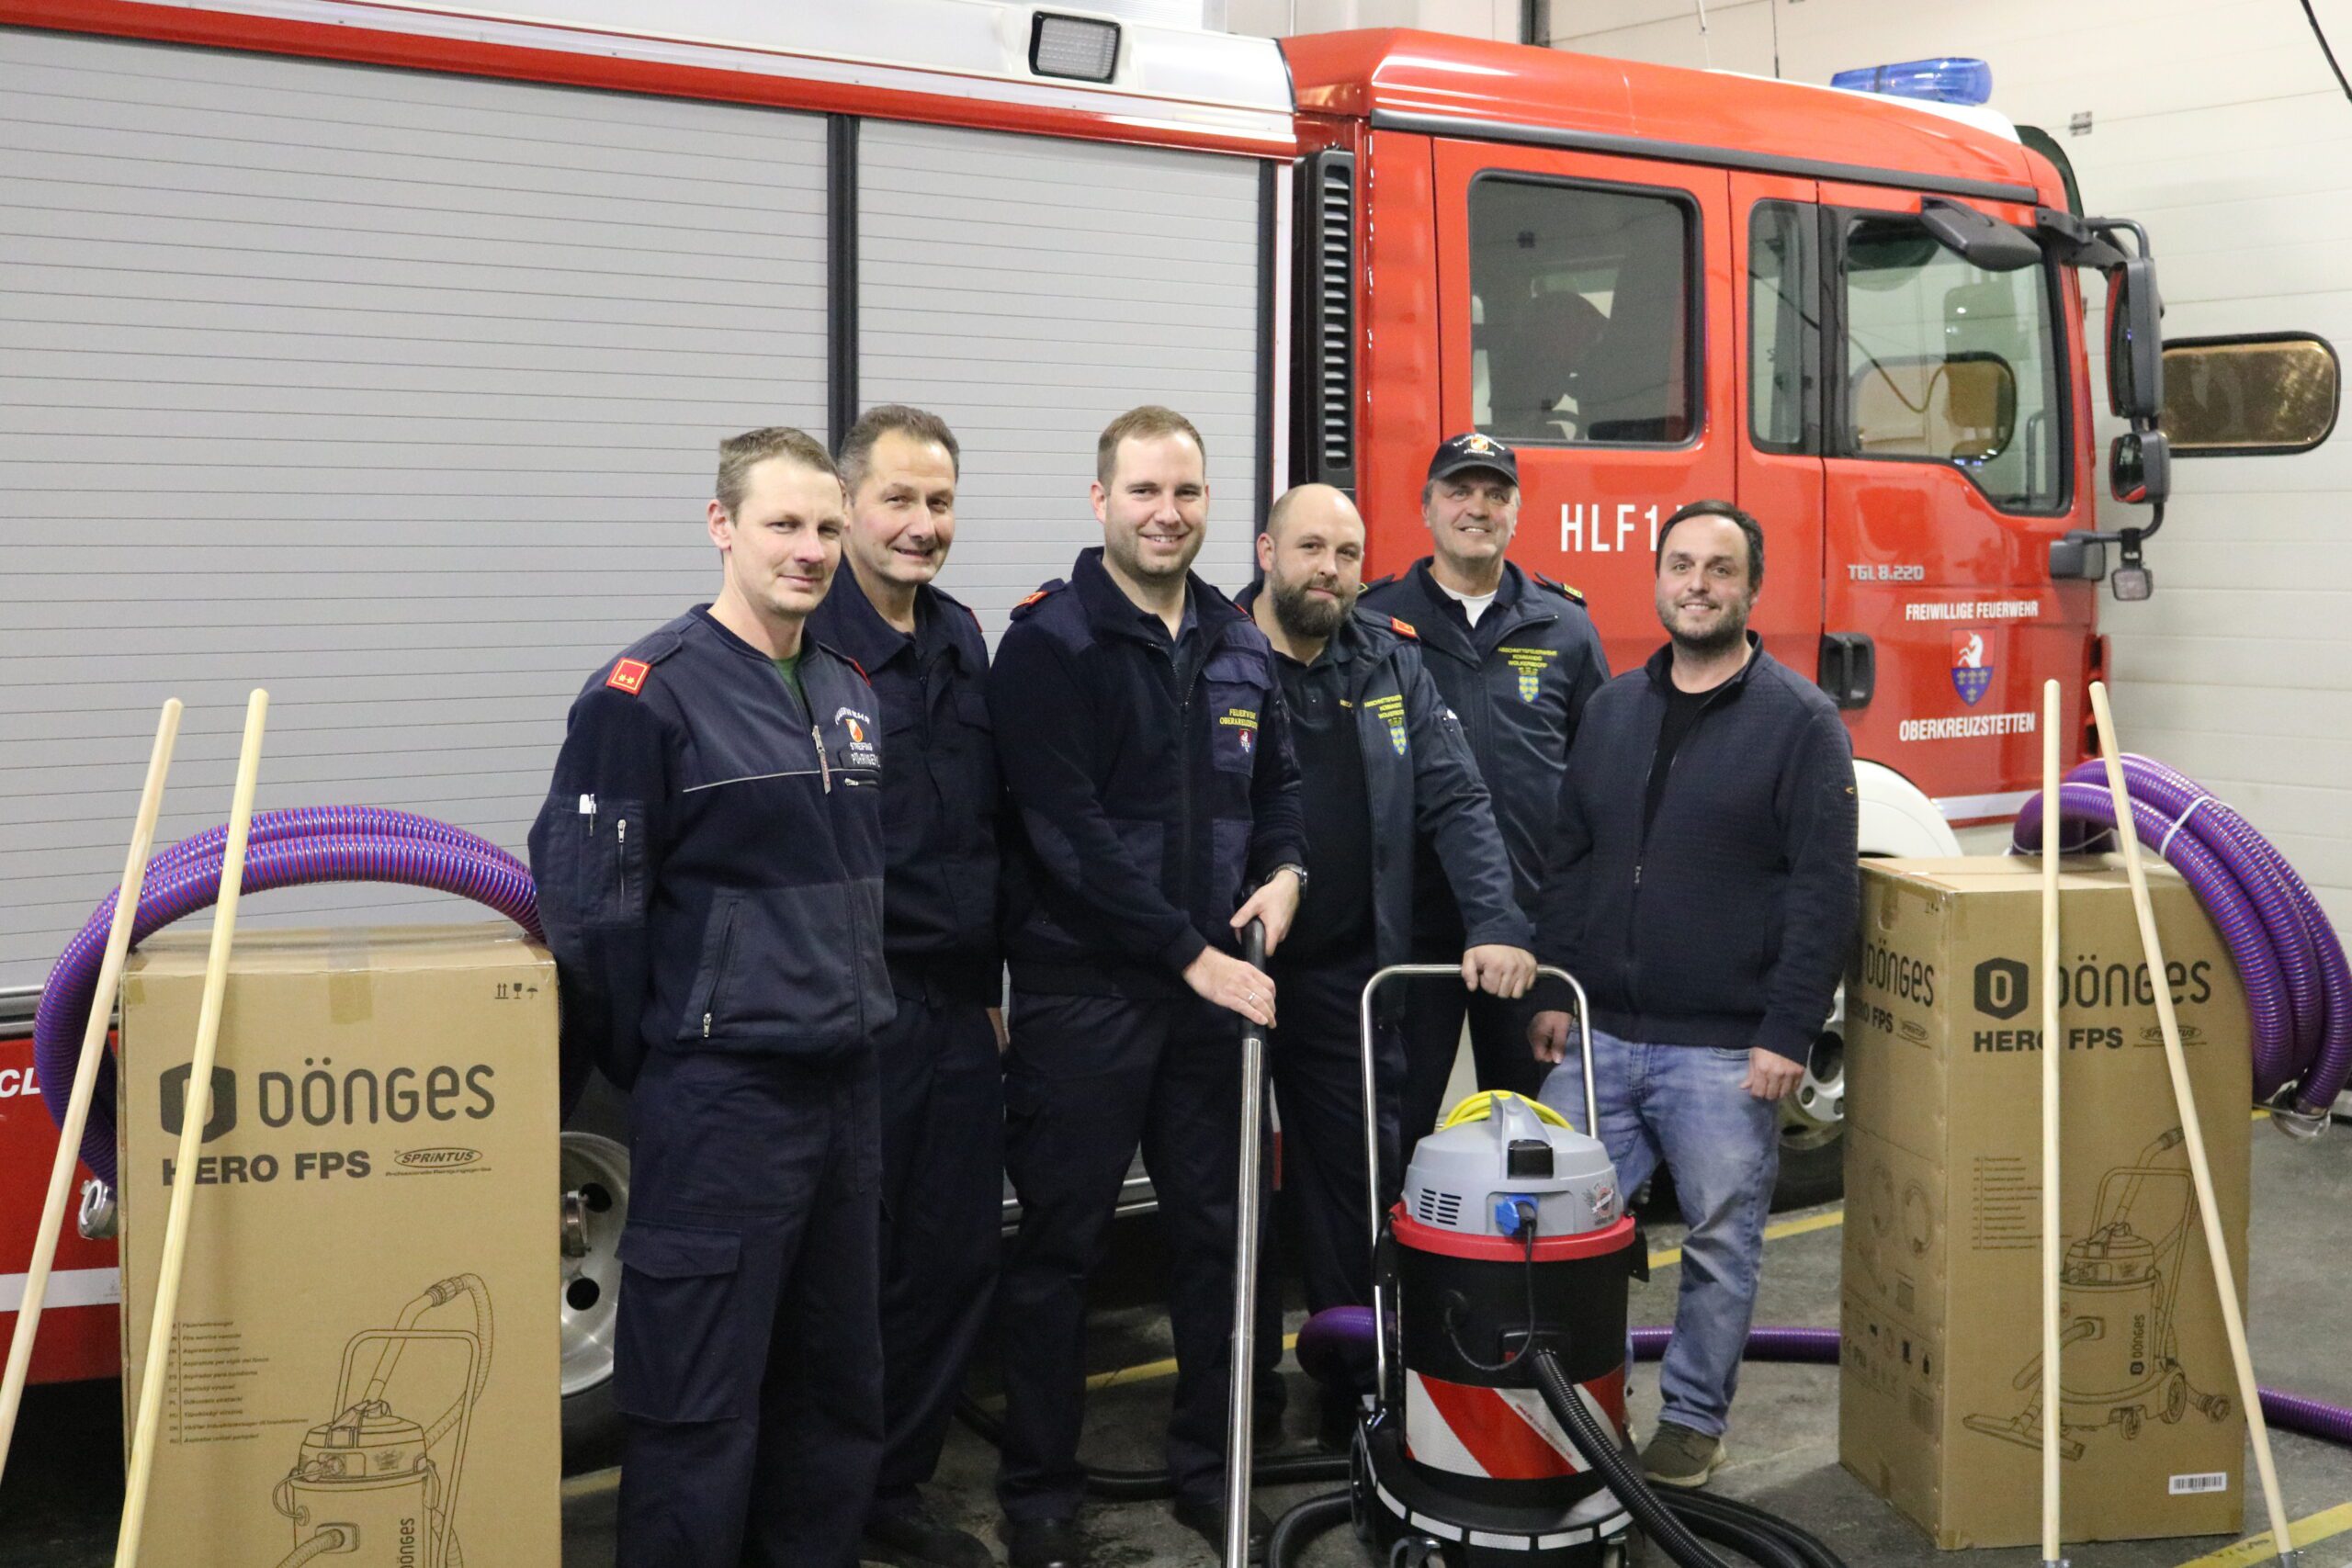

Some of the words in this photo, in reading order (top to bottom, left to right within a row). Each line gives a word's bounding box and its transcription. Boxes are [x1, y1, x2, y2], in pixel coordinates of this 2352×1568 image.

[1560, 504, 1683, 552] HLF1
[1848, 565, 1875, 581] TGL
[1878, 565, 1925, 581] 8.220
[1905, 603, 1973, 620] FREIWILLIGE
[1976, 601, 2039, 618] FEUERWEHR
[1899, 712, 2036, 741] OBERKREUZSTETTEN
[1872, 1007, 1894, 1033] FPS
[1973, 1030, 2043, 1053] HER
[2069, 1027, 2123, 1050] FPS
[295, 1151, 371, 1180] FPS
